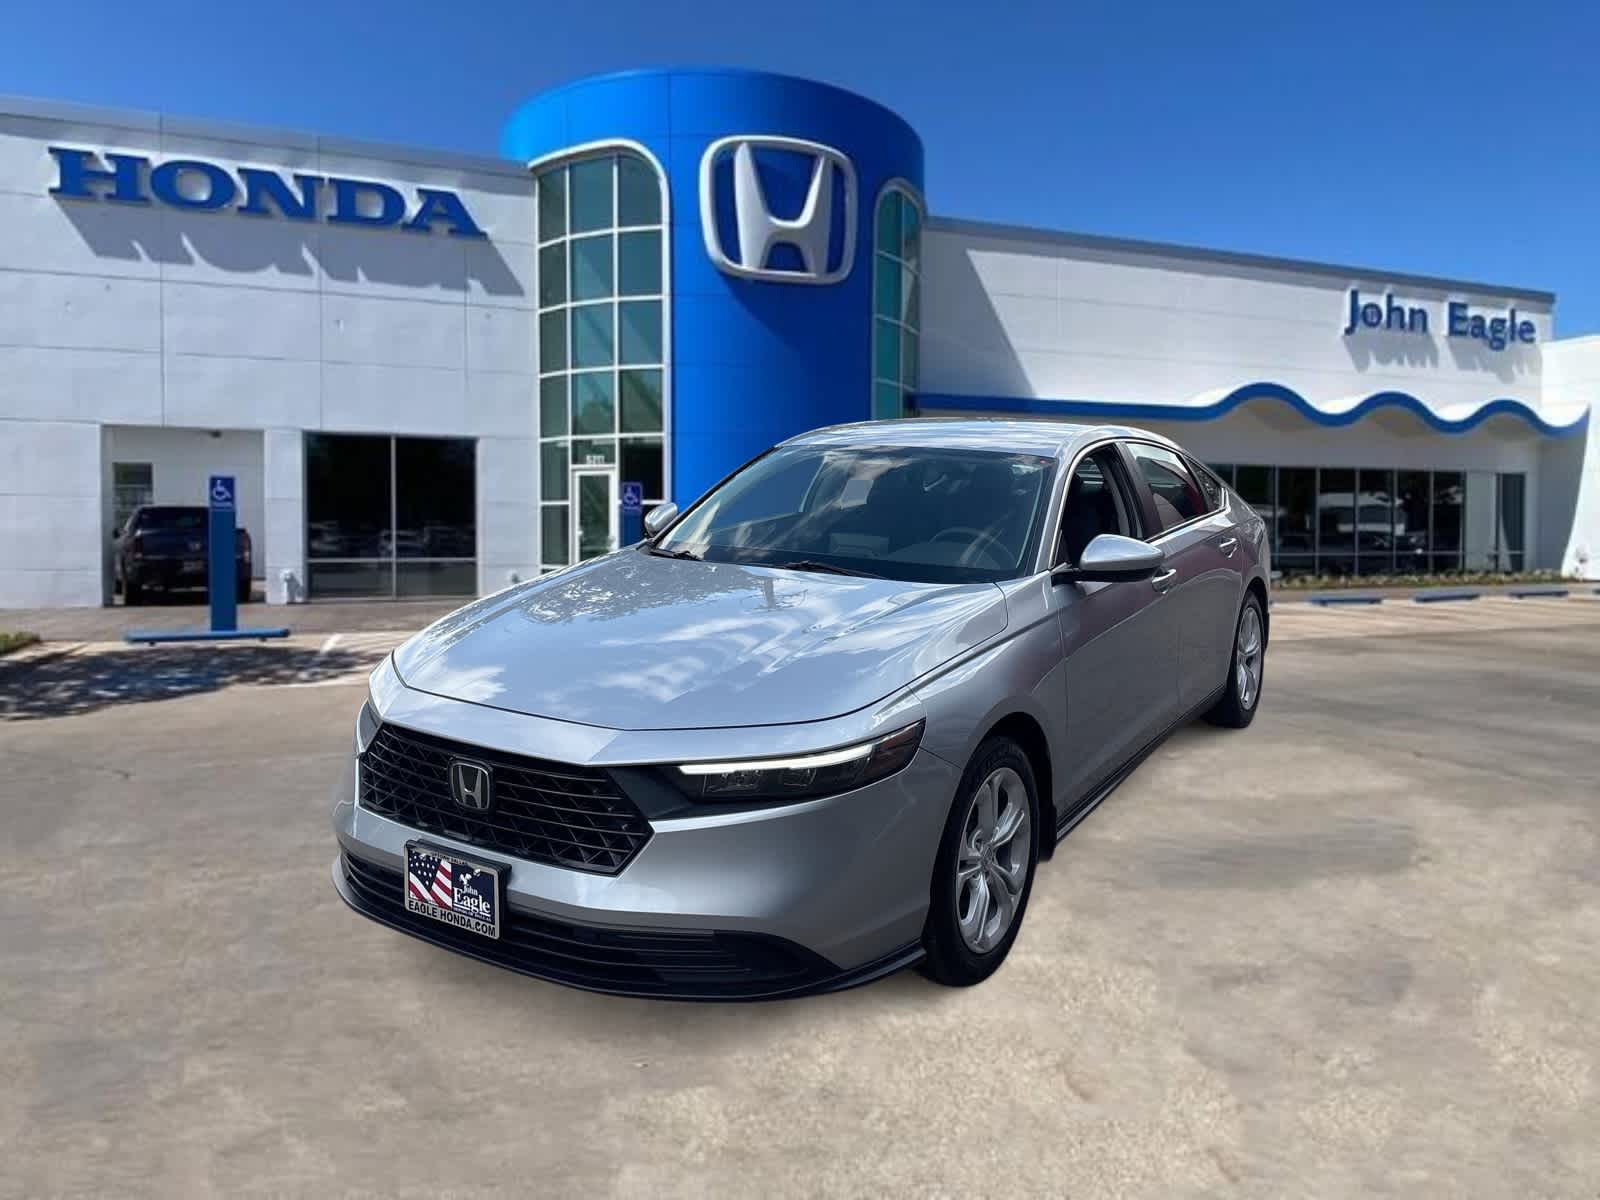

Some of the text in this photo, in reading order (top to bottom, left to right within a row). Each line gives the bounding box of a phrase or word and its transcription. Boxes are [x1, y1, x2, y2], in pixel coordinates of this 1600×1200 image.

[48, 146, 488, 239] HONDA
[1344, 289, 1536, 351] John Eagle
[453, 887, 491, 914] Eagle
[463, 884, 478, 896] John
[408, 900, 438, 917] EAGLE
[440, 908, 496, 937] HONDA.COM
